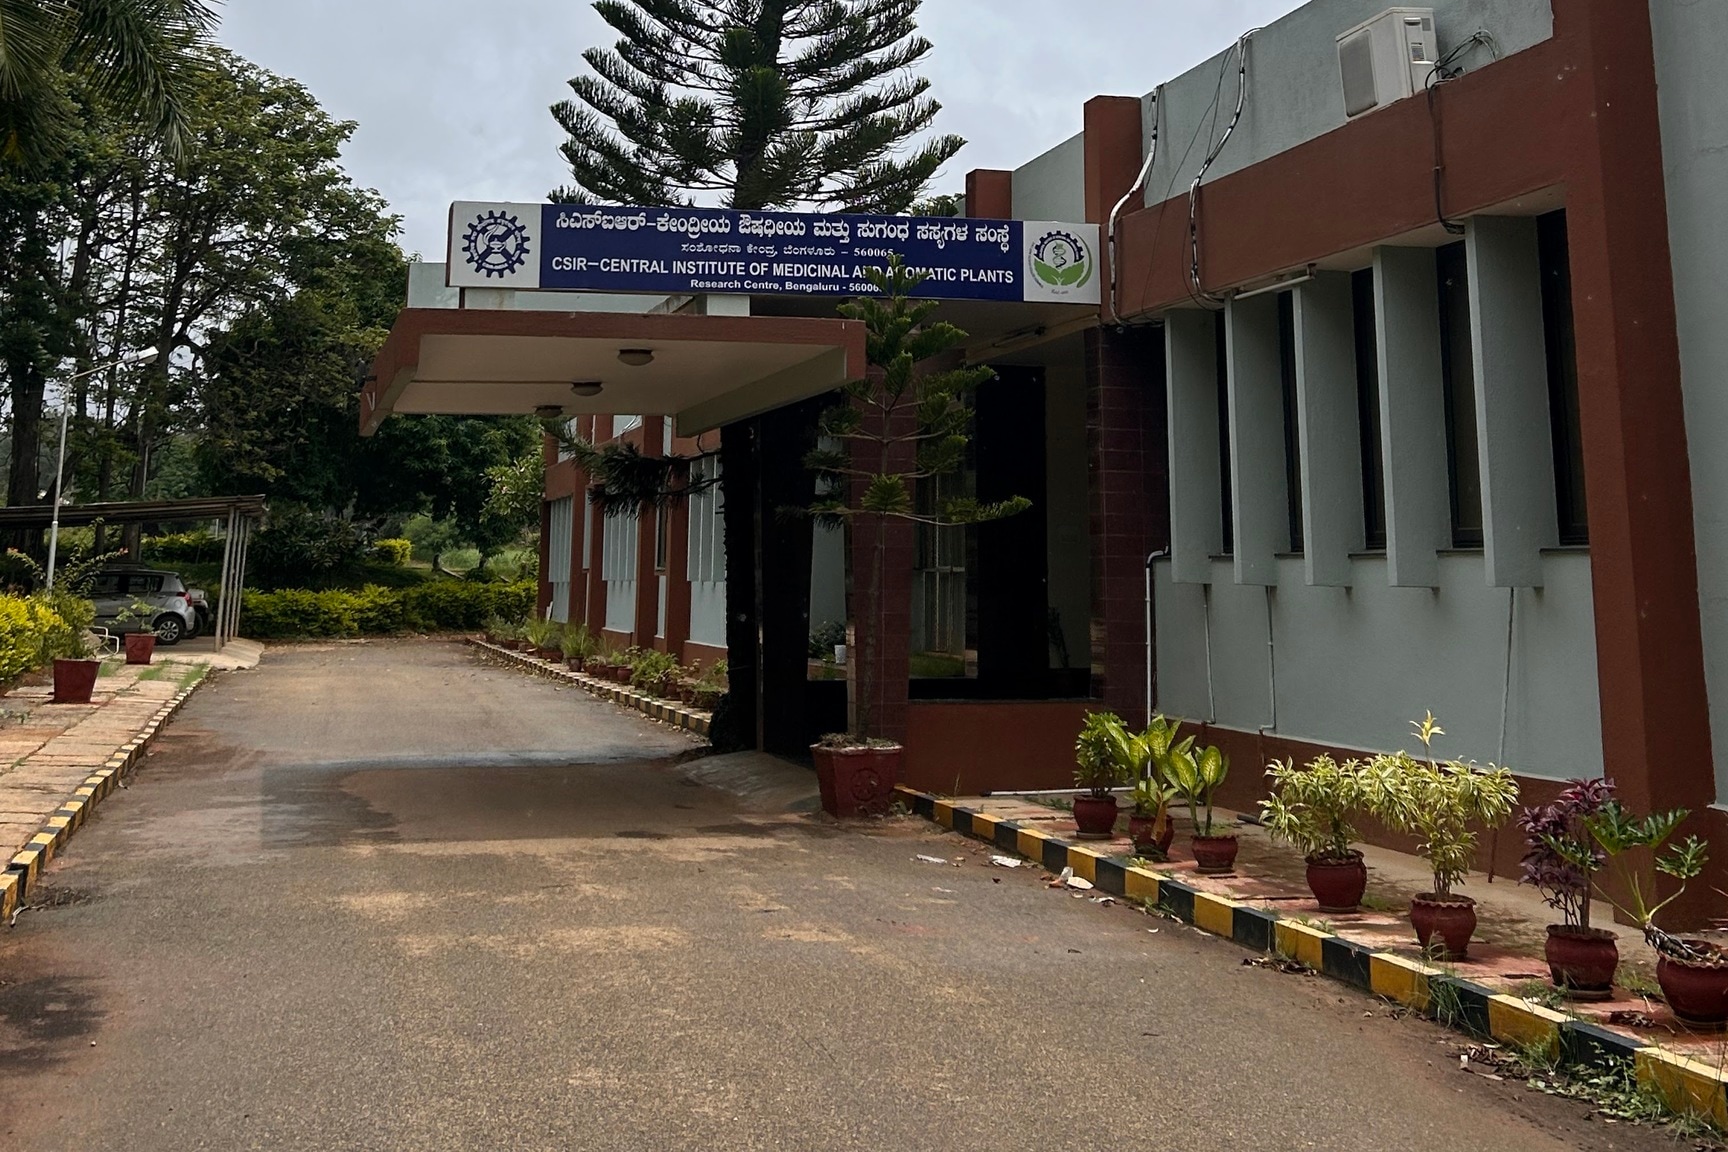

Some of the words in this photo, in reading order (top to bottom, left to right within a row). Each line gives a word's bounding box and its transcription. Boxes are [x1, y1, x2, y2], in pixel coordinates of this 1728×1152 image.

[813, 218, 850, 243] ಮತ್ತು
[857, 219, 910, 242] ಸುಗಂಧ
[916, 221, 968, 249] ಸಸ್ಯಗಳ
[975, 224, 1010, 253] ಸಂಸ್ಥೆ
[783, 244, 836, 256] ಬೆಂಗಳೂರು
[672, 260, 746, 276] INSTITUTE
[749, 262, 769, 276] OF
[773, 263, 849, 278] MEDICINAL
[886, 266, 957, 281] AOMATIC
[960, 268, 1014, 284] PLANTS
[690, 279, 741, 289] Research
[744, 280, 782, 291] Centre,
[785, 282, 840, 293] Bengaluru
[849, 283, 882, 293] 56006
